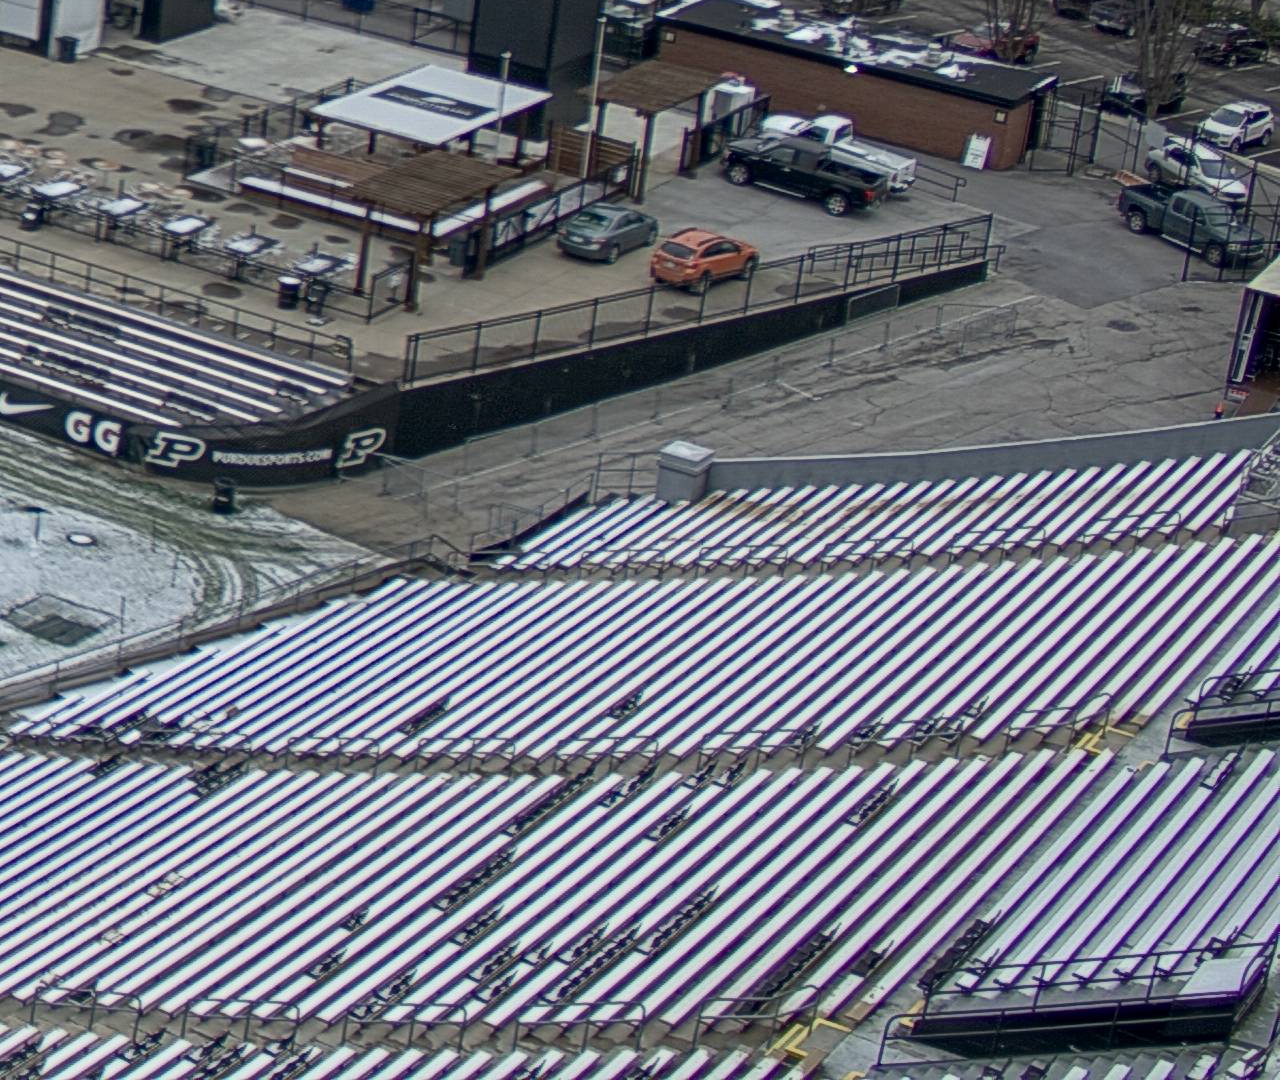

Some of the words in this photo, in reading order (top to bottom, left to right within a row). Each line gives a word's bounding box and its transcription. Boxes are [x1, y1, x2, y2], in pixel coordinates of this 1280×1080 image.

[64, 410, 122, 453] GG
[145, 431, 207, 469] P
[337, 427, 387, 469] P
